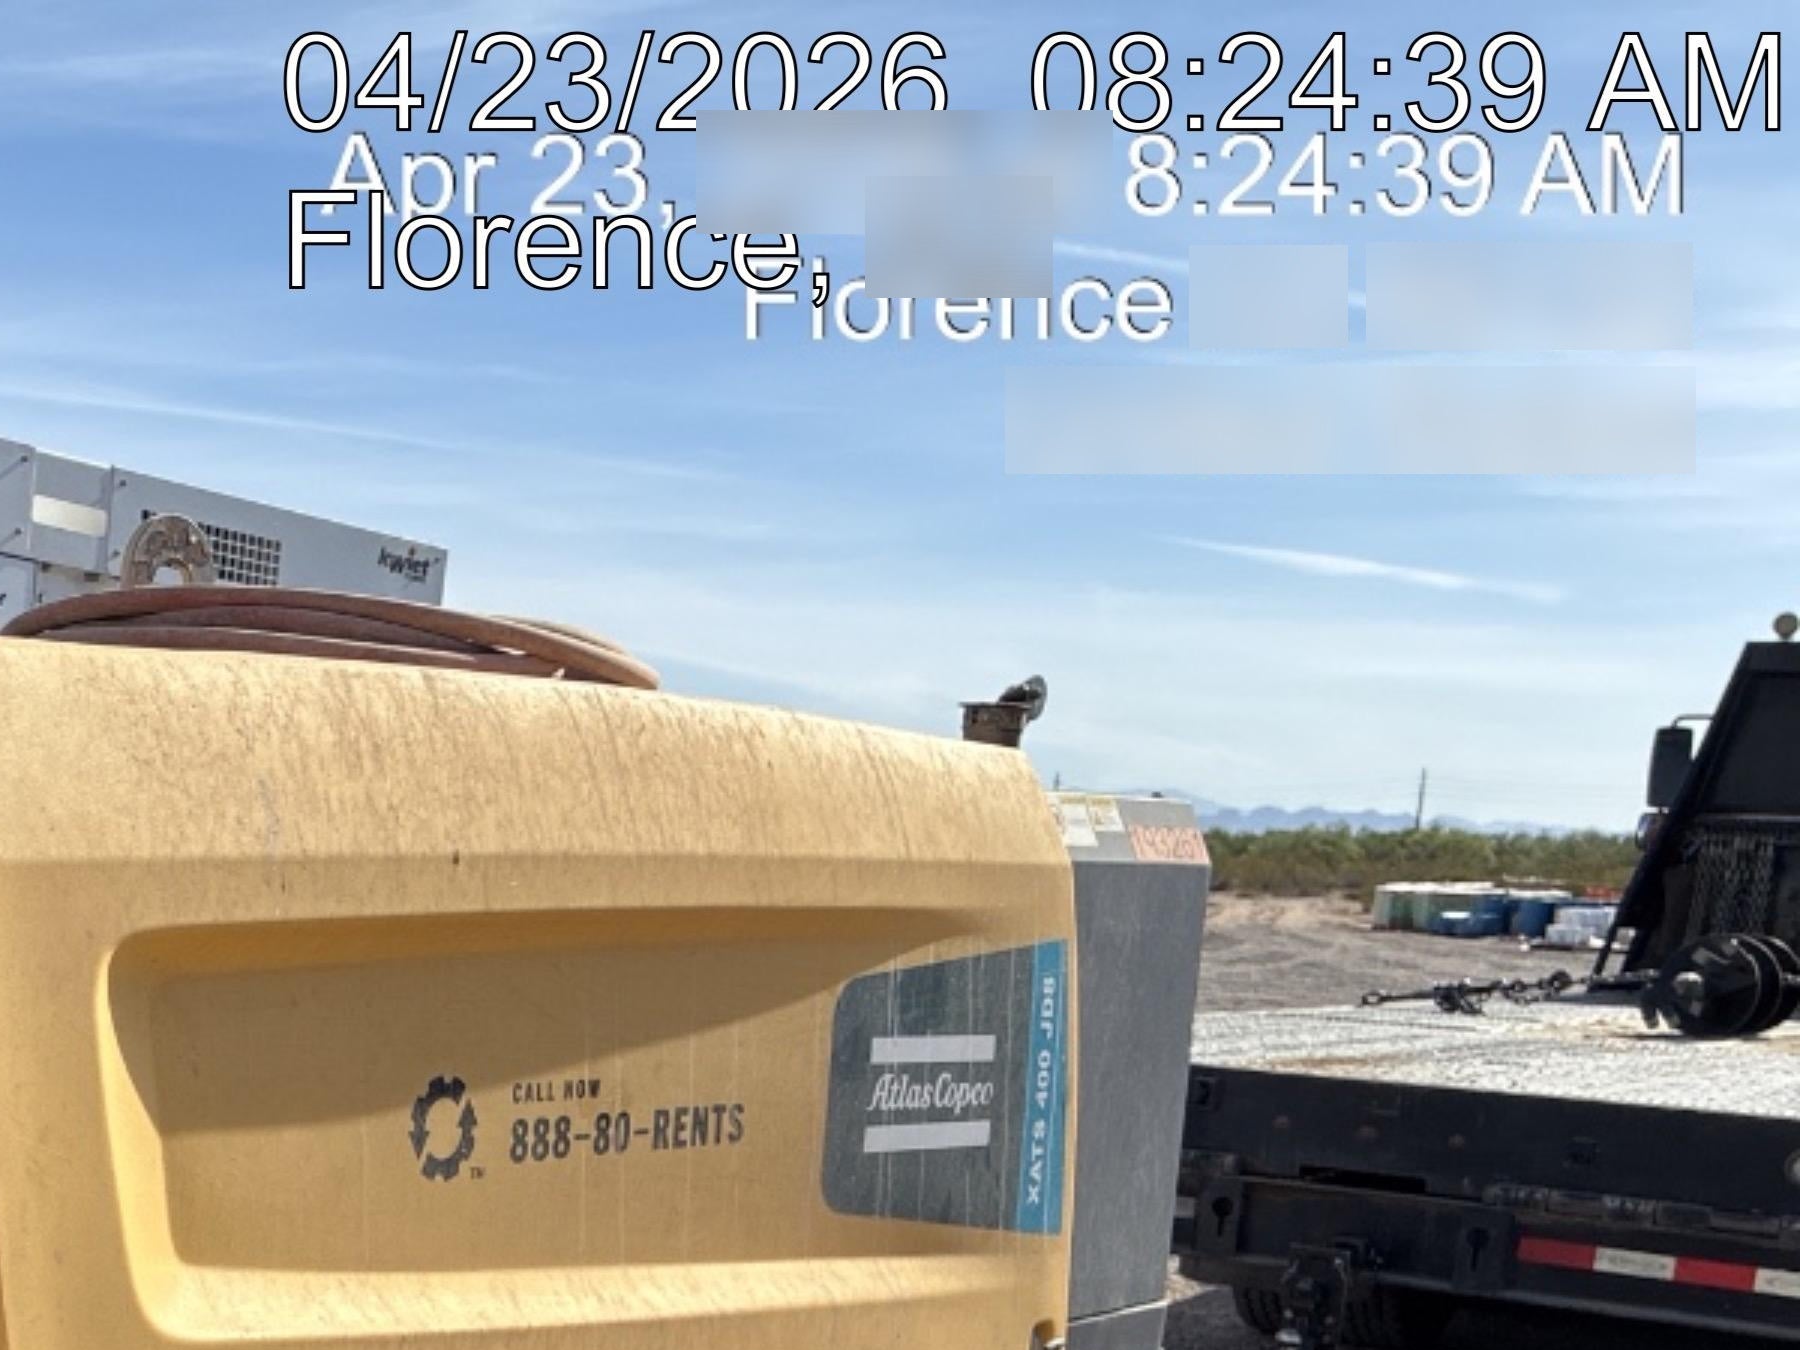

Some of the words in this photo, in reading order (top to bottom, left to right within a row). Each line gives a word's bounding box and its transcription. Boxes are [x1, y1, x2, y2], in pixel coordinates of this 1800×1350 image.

[512, 1081, 555, 1104] CALL
[564, 1078, 601, 1100] NOW
[1035, 1049, 1051, 1110] 400
[509, 1103, 745, 1164] 888-80-RENTS
[1027, 1119, 1046, 1205] XATS
